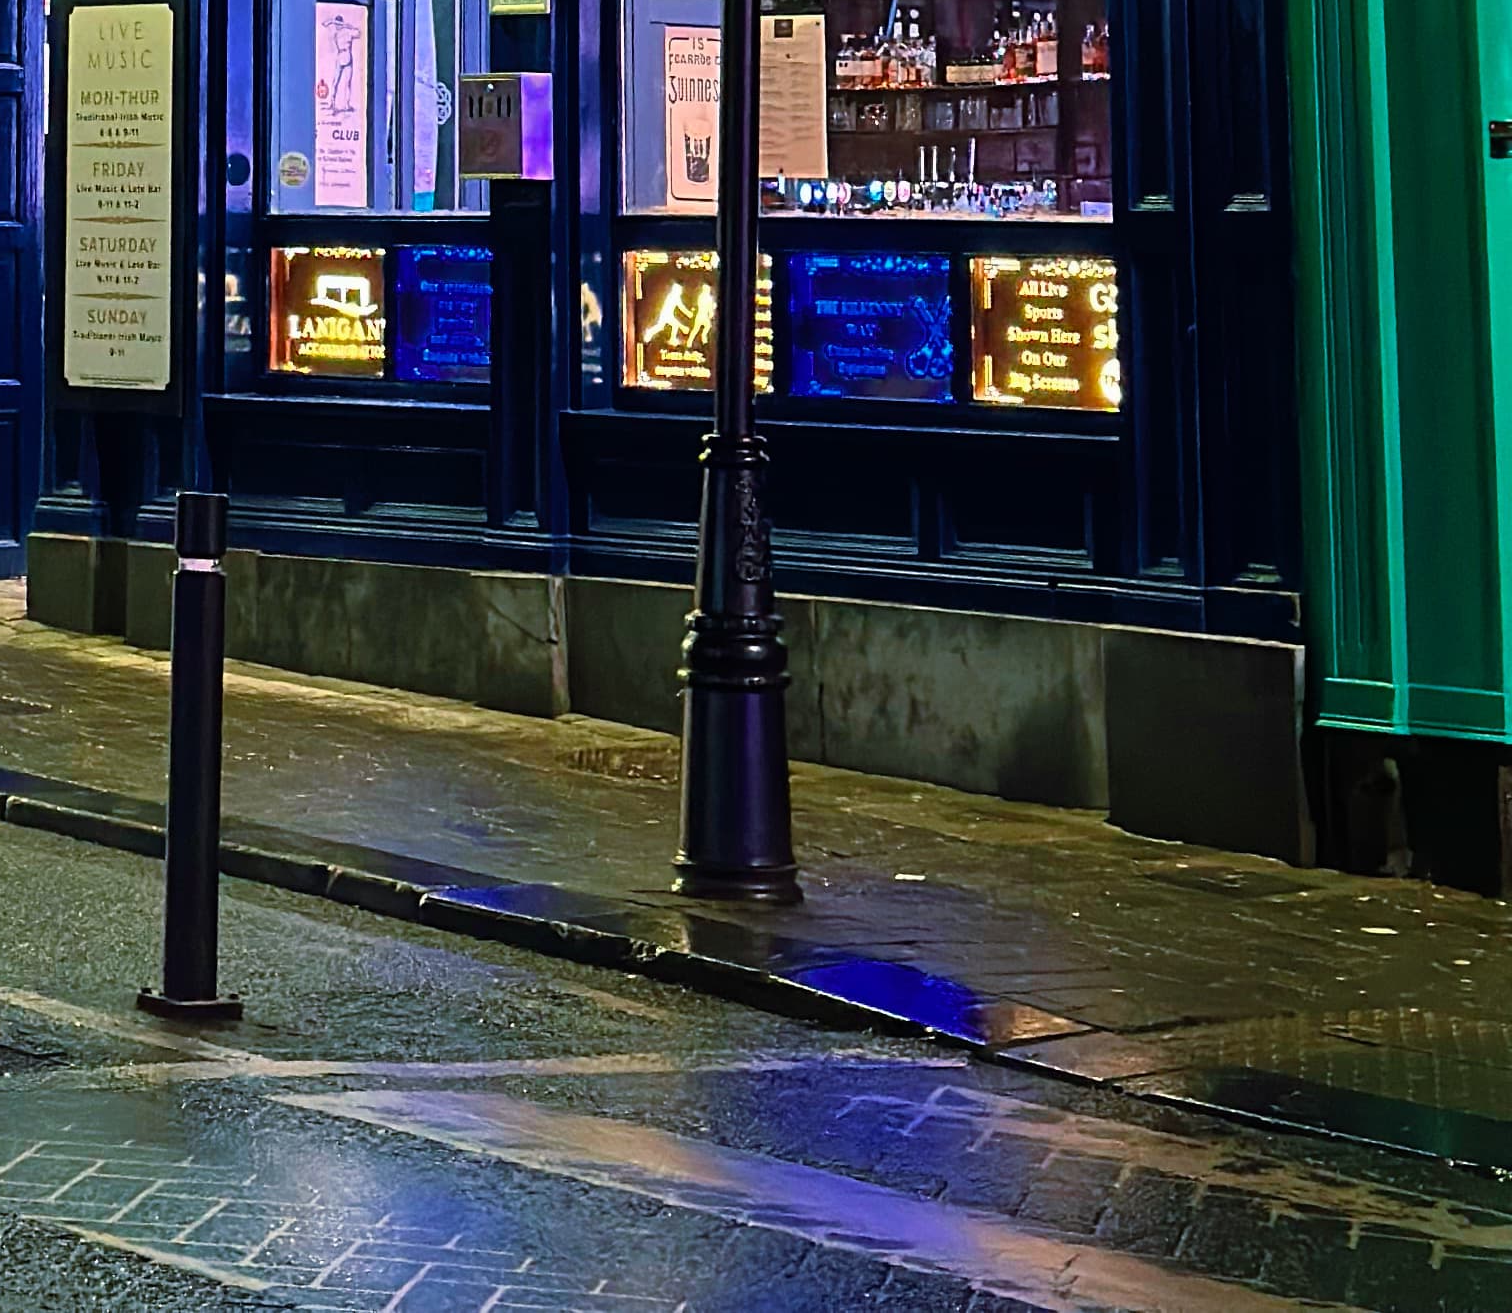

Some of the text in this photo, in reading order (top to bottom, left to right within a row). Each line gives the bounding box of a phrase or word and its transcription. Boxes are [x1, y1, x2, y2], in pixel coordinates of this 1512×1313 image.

[98, 20, 145, 41] LIVE
[87, 49, 153, 69] MUSIC
[80, 89, 160, 106] MON-THUR
[331, 129, 360, 141] CLUB
[92, 161, 145, 178] FRIDAY
[79, 236, 158, 253] SATURDAY
[87, 309, 148, 325] SUNDAY
[1024, 303, 1065, 323] Sports
[1008, 325, 1082, 345] Shown Here
[1020, 349, 1068, 368] On Our
